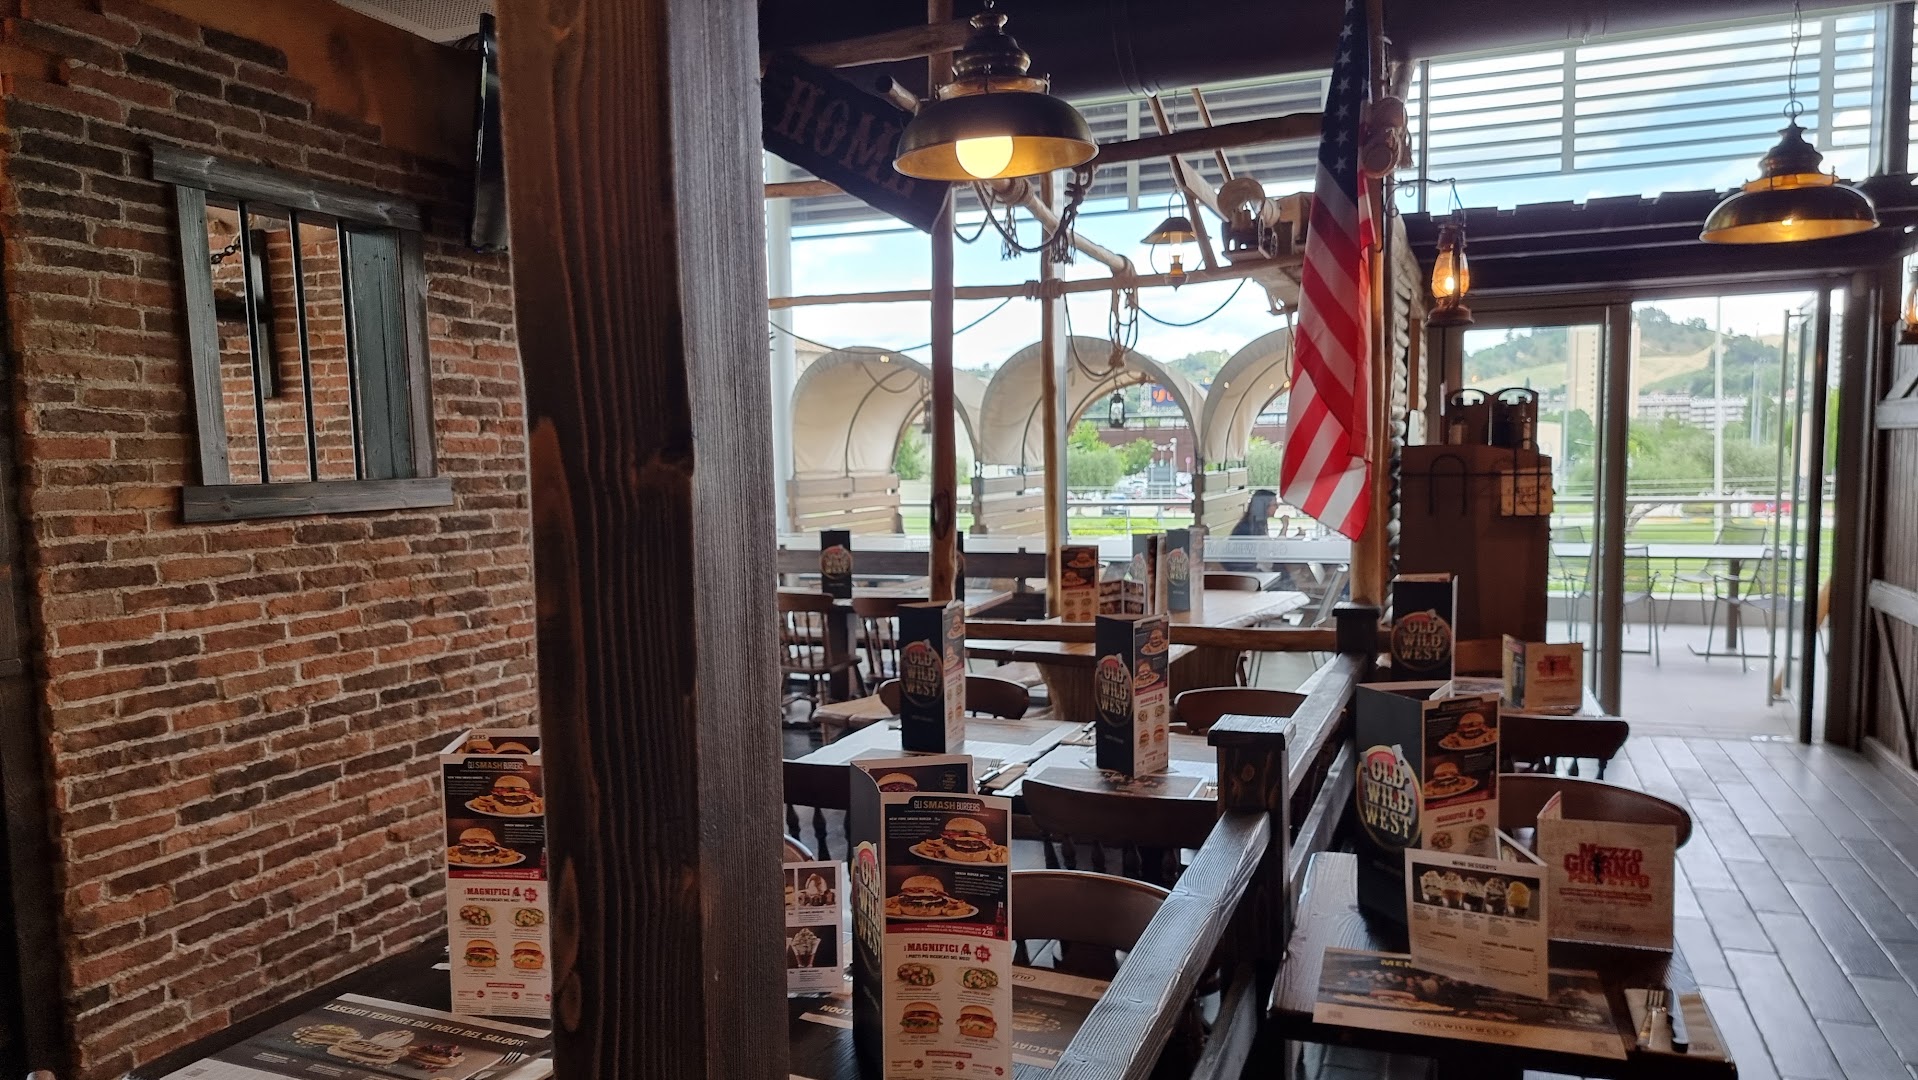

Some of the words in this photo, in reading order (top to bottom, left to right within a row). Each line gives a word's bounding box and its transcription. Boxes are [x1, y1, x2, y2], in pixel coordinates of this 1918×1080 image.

[773, 75, 916, 198] HOM
[1407, 621, 1438, 633] OLD
[1402, 633, 1441, 647] WILD
[909, 651, 933, 666] OLD
[1400, 649, 1441, 660] WEST
[906, 665, 937, 681] WILD
[1103, 665, 1124, 683] OLD
[906, 681, 938, 697] WEST
[1101, 682, 1127, 700] WILD
[1100, 698, 1128, 717] WEST
[475, 761, 503, 770] SMASH
[1370, 758, 1405, 789] OLD
[913, 799, 922, 809] GLI
[923, 800, 956, 810] SMASH
[956, 802, 981, 812] BURGERS
[1366, 782, 1411, 813] WILD
[1365, 803, 1413, 840] WEST
[467, 887, 510, 896] MAGNIFICI
[907, 943, 959, 953] MAGNIFICI
[961, 943, 970, 953] 4
[1380, 958, 1412, 968] MEN
[819, 1004, 853, 1017] LOON
[322, 1003, 371, 1017] LASCIATI
[368, 1011, 414, 1025] TENTARE
[411, 1020, 433, 1029] DAI
[460, 1030, 482, 1039] DEL
[1011, 1041, 1065, 1057] LASCIAT
